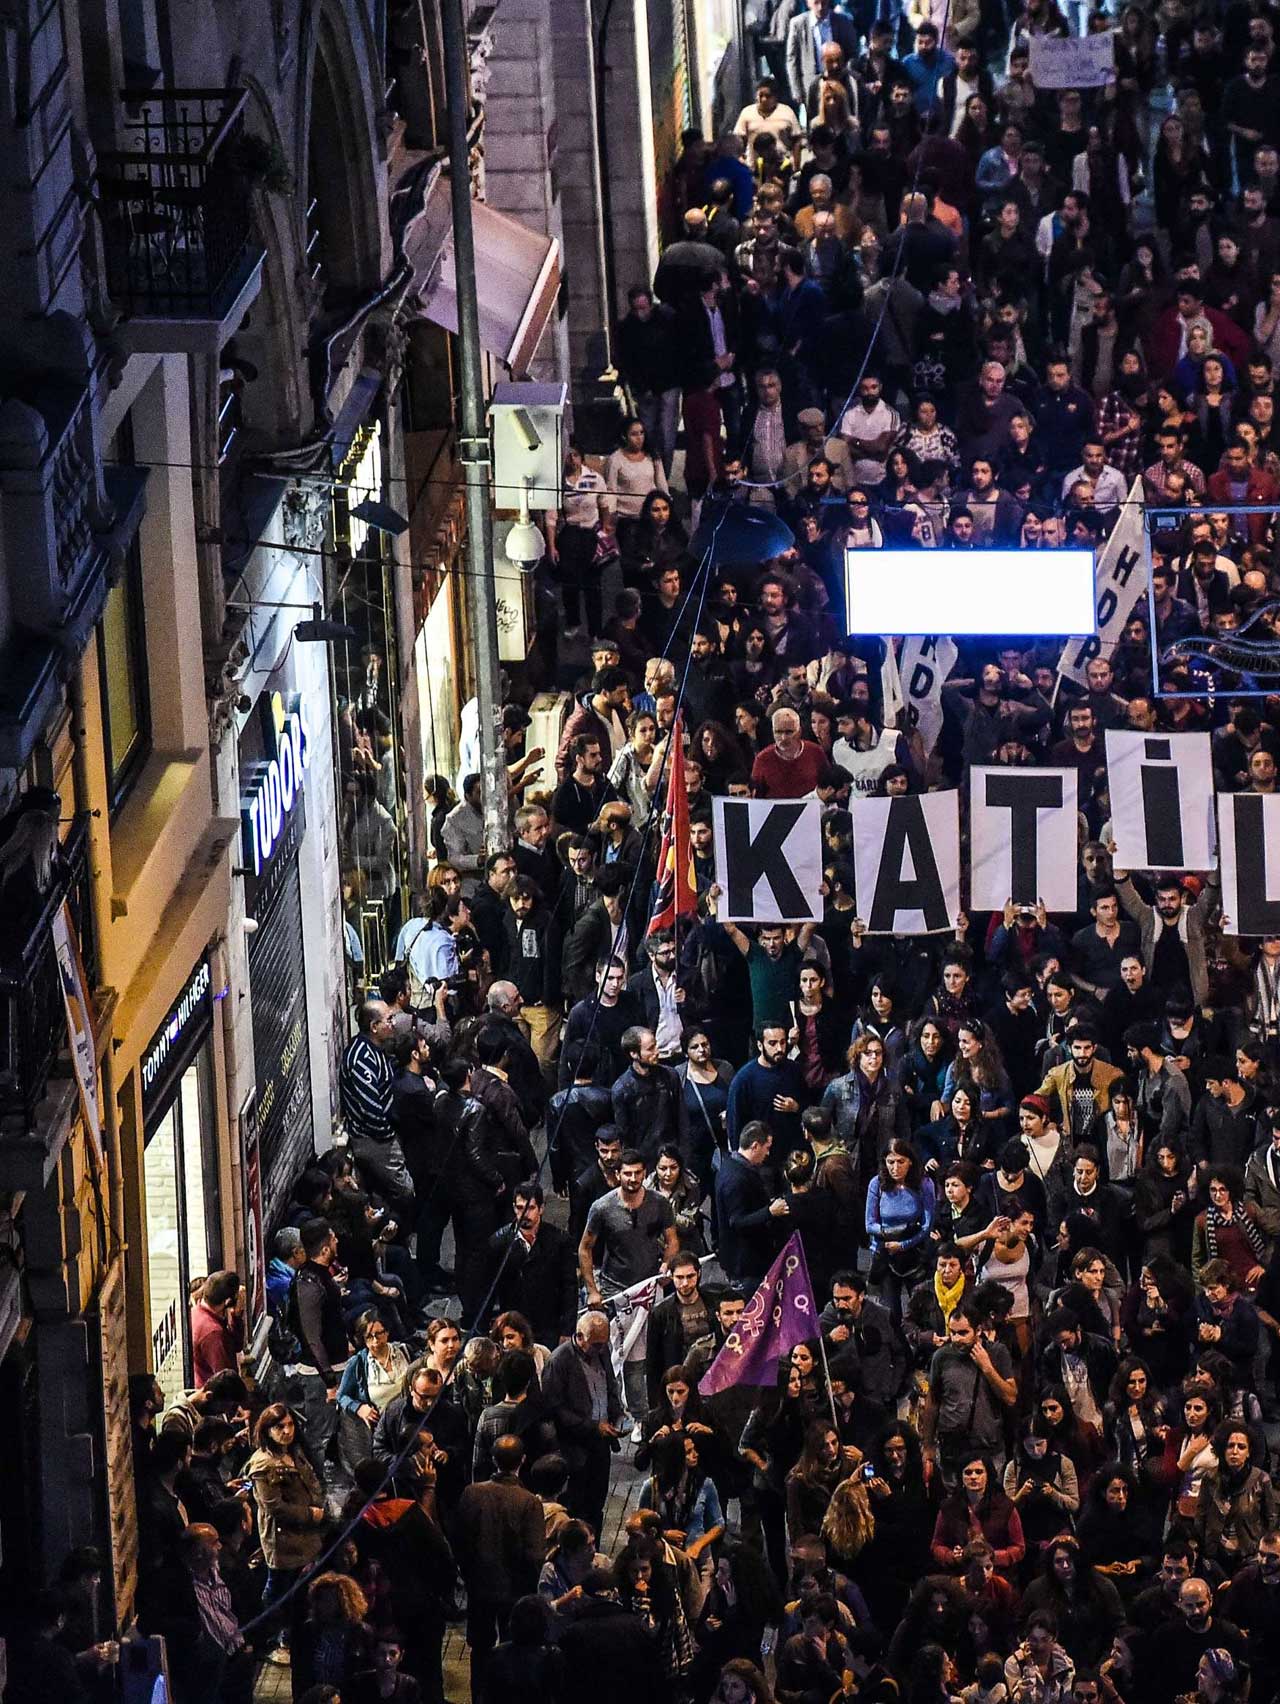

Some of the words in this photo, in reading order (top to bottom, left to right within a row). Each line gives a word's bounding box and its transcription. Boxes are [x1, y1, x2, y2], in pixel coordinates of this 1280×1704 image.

[1073, 543, 1141, 670] HDP
[250, 692, 310, 876] TUDORS
[142, 1024, 171, 1092] TOMMY
[177, 962, 210, 1031] HILFIGER
